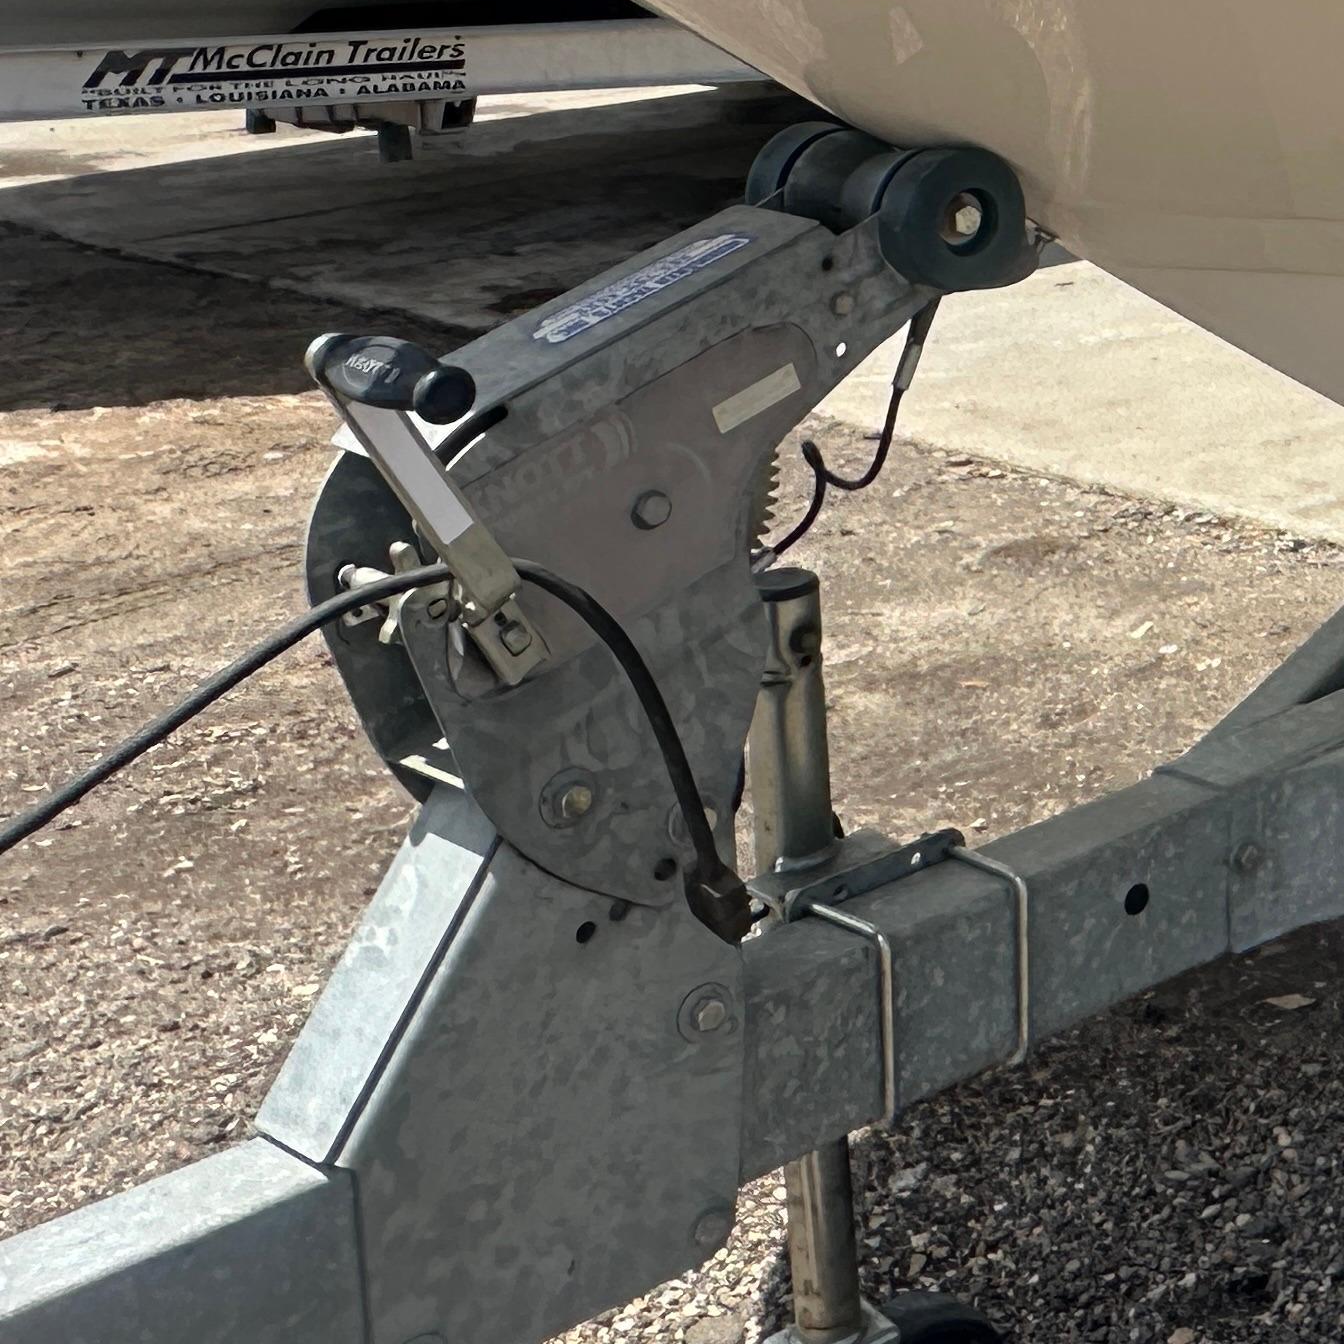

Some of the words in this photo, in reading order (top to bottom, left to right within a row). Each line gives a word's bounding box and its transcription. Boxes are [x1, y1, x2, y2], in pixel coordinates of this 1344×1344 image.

[189, 42, 336, 72] McClain
[347, 36, 466, 64] Trailers
[81, 95, 166, 111] TEXAS
[195, 87, 329, 105] LOUISIANA
[356, 79, 466, 96] ALABAMA
